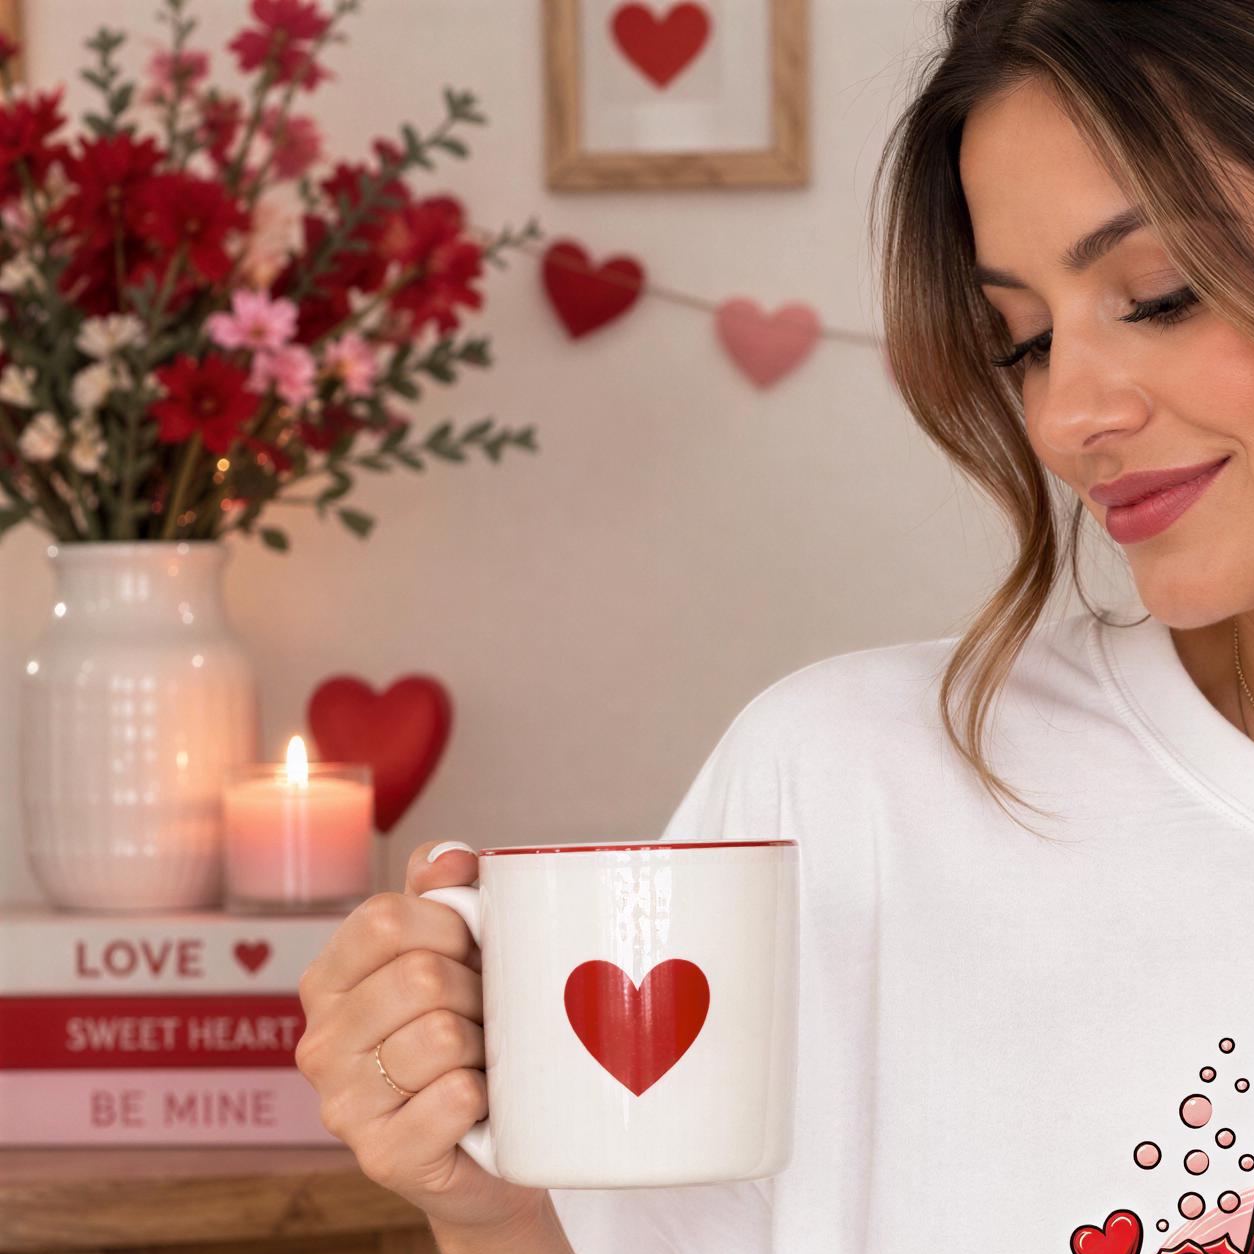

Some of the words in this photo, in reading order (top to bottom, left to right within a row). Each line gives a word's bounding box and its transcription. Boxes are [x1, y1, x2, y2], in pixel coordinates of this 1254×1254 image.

[76, 940, 203, 977] LOVE
[65, 1017, 181, 1051] SWEET
[189, 1017, 299, 1049] HEART
[90, 1090, 144, 1128] BE
[163, 1090, 278, 1127] MINE
